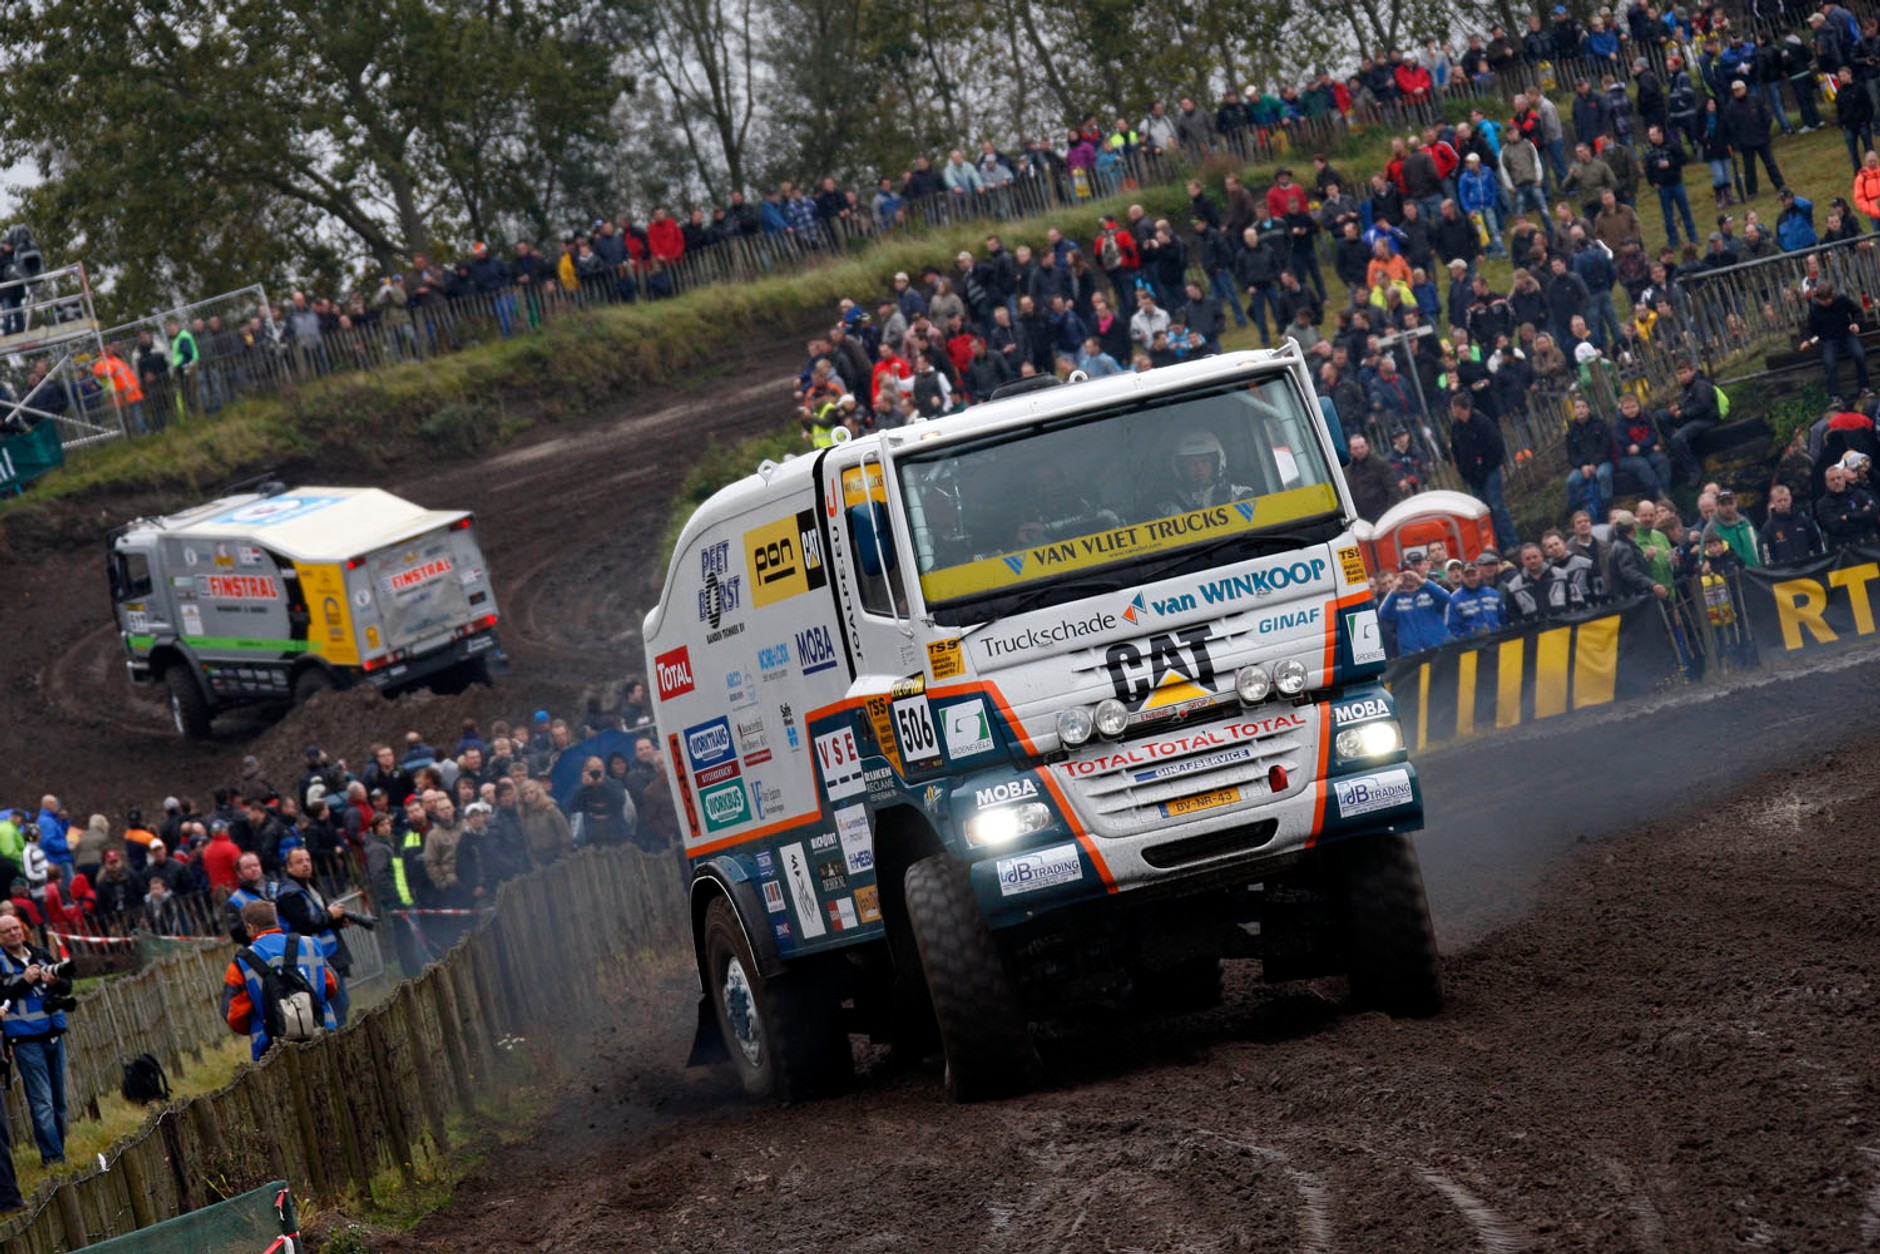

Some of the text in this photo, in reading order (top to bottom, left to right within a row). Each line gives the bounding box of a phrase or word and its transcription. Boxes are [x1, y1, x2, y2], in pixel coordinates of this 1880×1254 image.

[801, 529, 822, 570] CAT
[1033, 507, 1230, 567] VAN VLIET TRUCKS
[389, 557, 453, 590] FINSTRAL
[701, 539, 730, 580] PEET
[754, 537, 794, 586] pon
[208, 575, 279, 599] FINSTRAL
[1151, 558, 1326, 616] van WINKOOP
[980, 612, 1117, 657] Truckschade
[1258, 607, 1321, 634] GINAF
[795, 625, 836, 667] MOBA
[928, 640, 958, 654] TSS
[656, 661, 692, 692] TOTAL
[1105, 624, 1219, 712] CAT
[866, 697, 887, 717] TSS
[1140, 708, 1169, 721] ENGINE
[1334, 699, 1389, 723] MOBA
[691, 727, 728, 754] WORKTRANS
[897, 705, 935, 754] 506
[1059, 713, 1307, 777] TOTAL TOTAL TOTAL
[707, 789, 741, 816] WORKBUS
[975, 778, 1037, 806] MOBA
[1175, 790, 1234, 811] BV-NR-43
[1369, 782, 1411, 800] TRADING
[1031, 859, 1080, 878] TRADING
